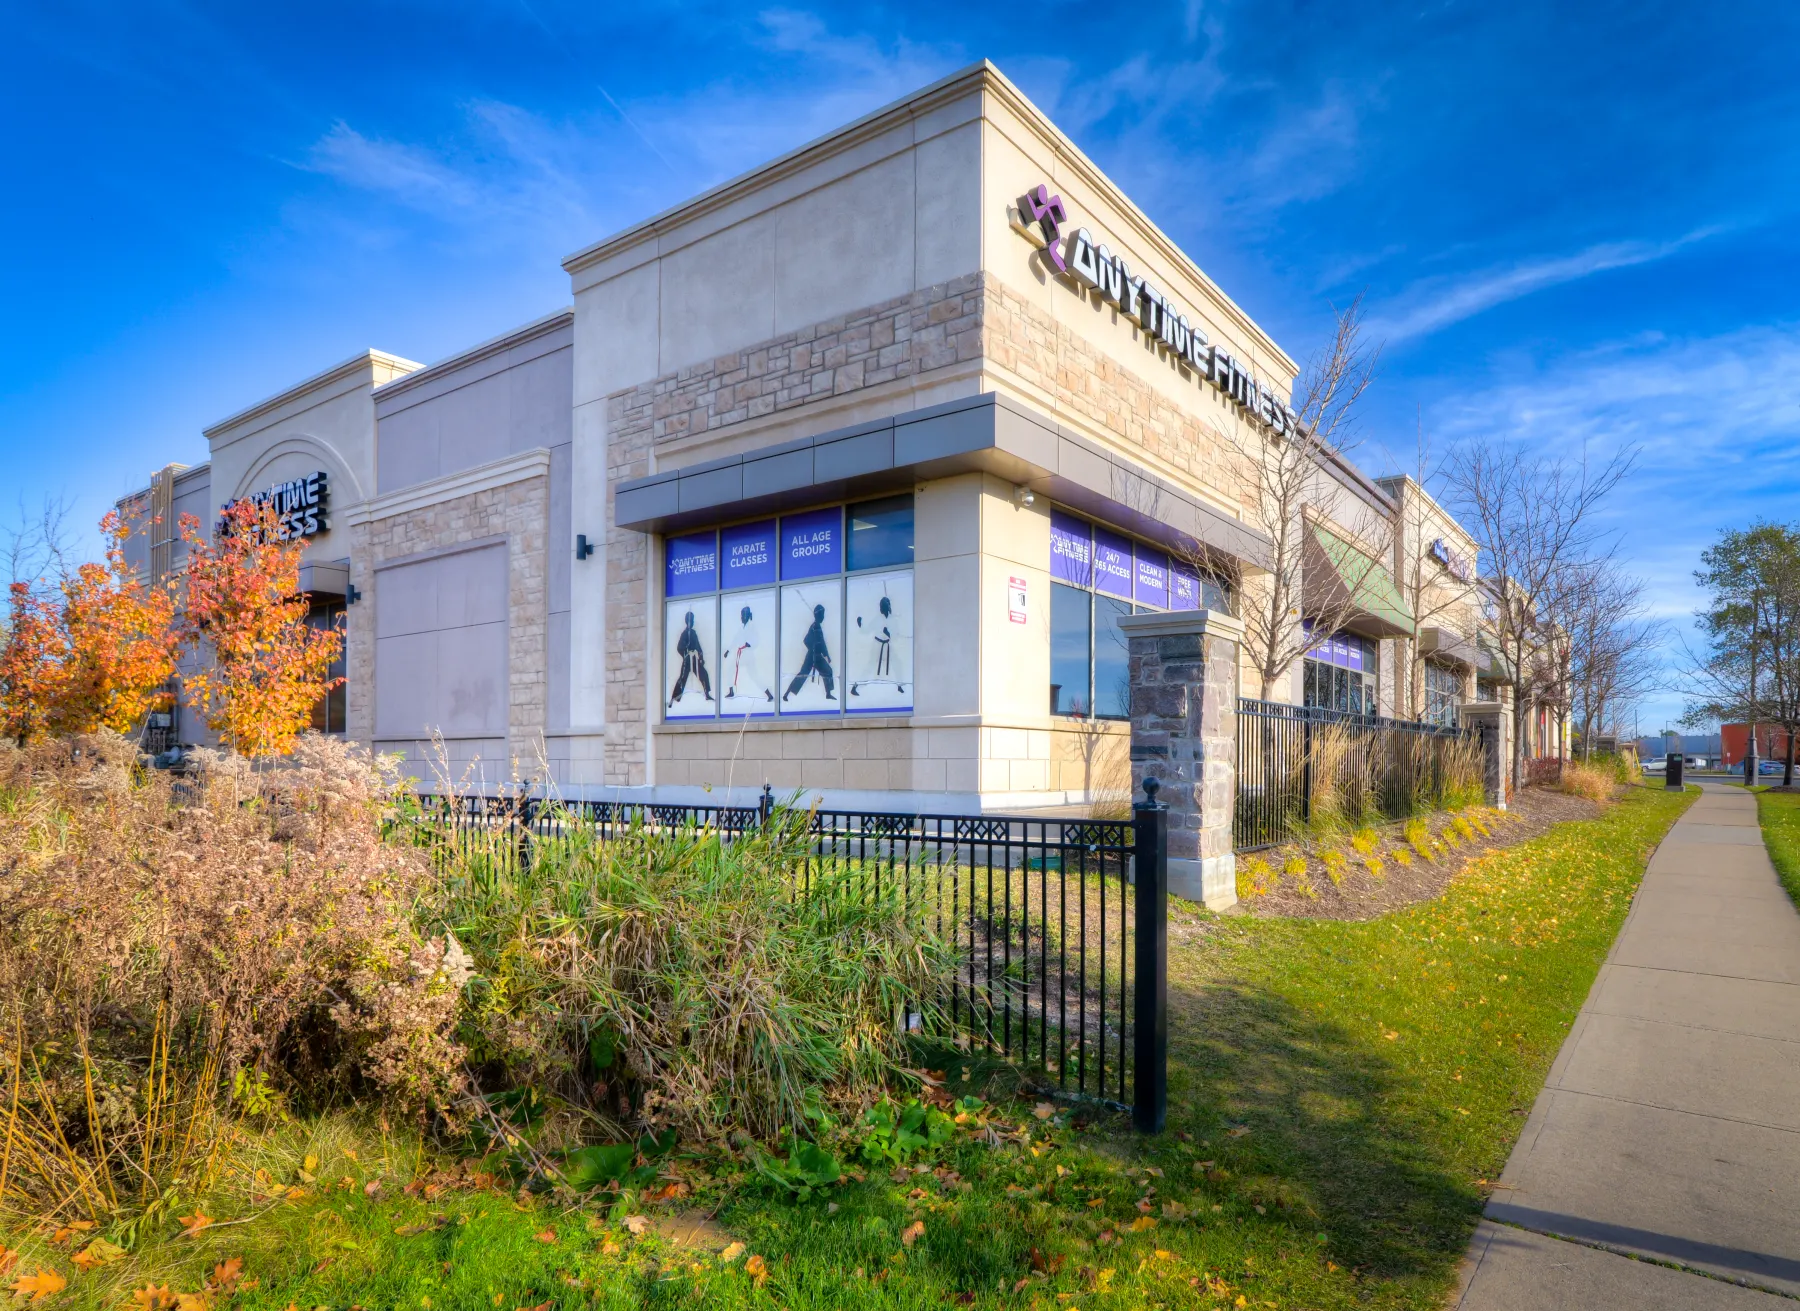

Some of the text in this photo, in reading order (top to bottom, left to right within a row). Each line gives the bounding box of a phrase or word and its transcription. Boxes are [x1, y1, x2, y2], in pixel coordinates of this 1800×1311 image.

[1066, 227, 1297, 442] ANYTIME FITNESS
[791, 530, 831, 546] ALL AGE
[732, 541, 766, 556] KARATE
[792, 543, 830, 558] GROUPS
[1057, 546, 1089, 564] FITNESS
[678, 553, 715, 568] ANYTIME
[730, 553, 767, 568] CLASSES
[1106, 552, 1120, 564] 24/7
[679, 562, 715, 575] FITNESS
[1095, 559, 1130, 579] 365 ACCESS
[1139, 563, 1158, 577] CLEAN
[1139, 574, 1163, 590] MODERN
